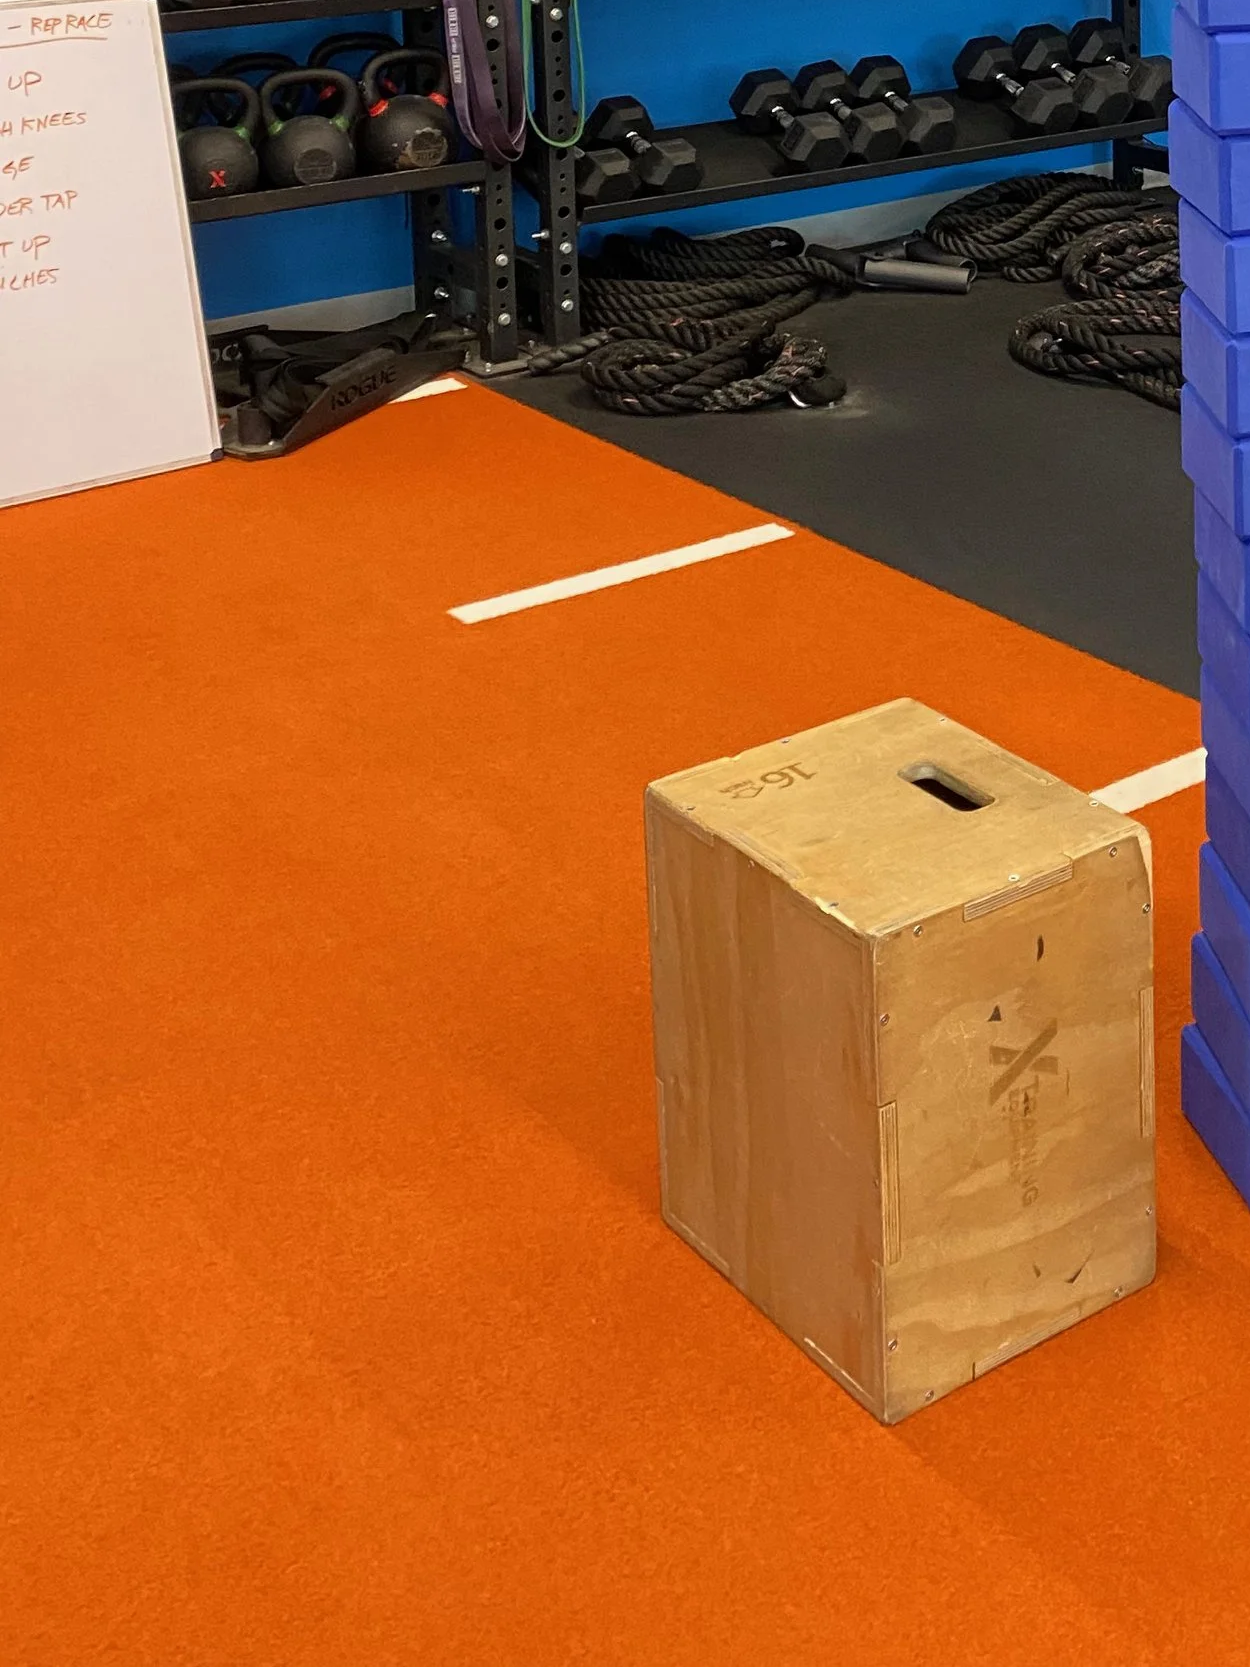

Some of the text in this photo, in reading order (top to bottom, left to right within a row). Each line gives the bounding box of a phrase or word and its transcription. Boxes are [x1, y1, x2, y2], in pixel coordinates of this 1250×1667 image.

[31, 17, 62, 35] REP
[65, 13, 114, 34] RACE
[8, 71, 42, 97] UP
[21, 112, 87, 135] KNEES
[40, 190, 79, 211] TAP
[22, 235, 51, 260] UP
[331, 365, 397, 411] ROGUE
[760, 761, 818, 791] 16
